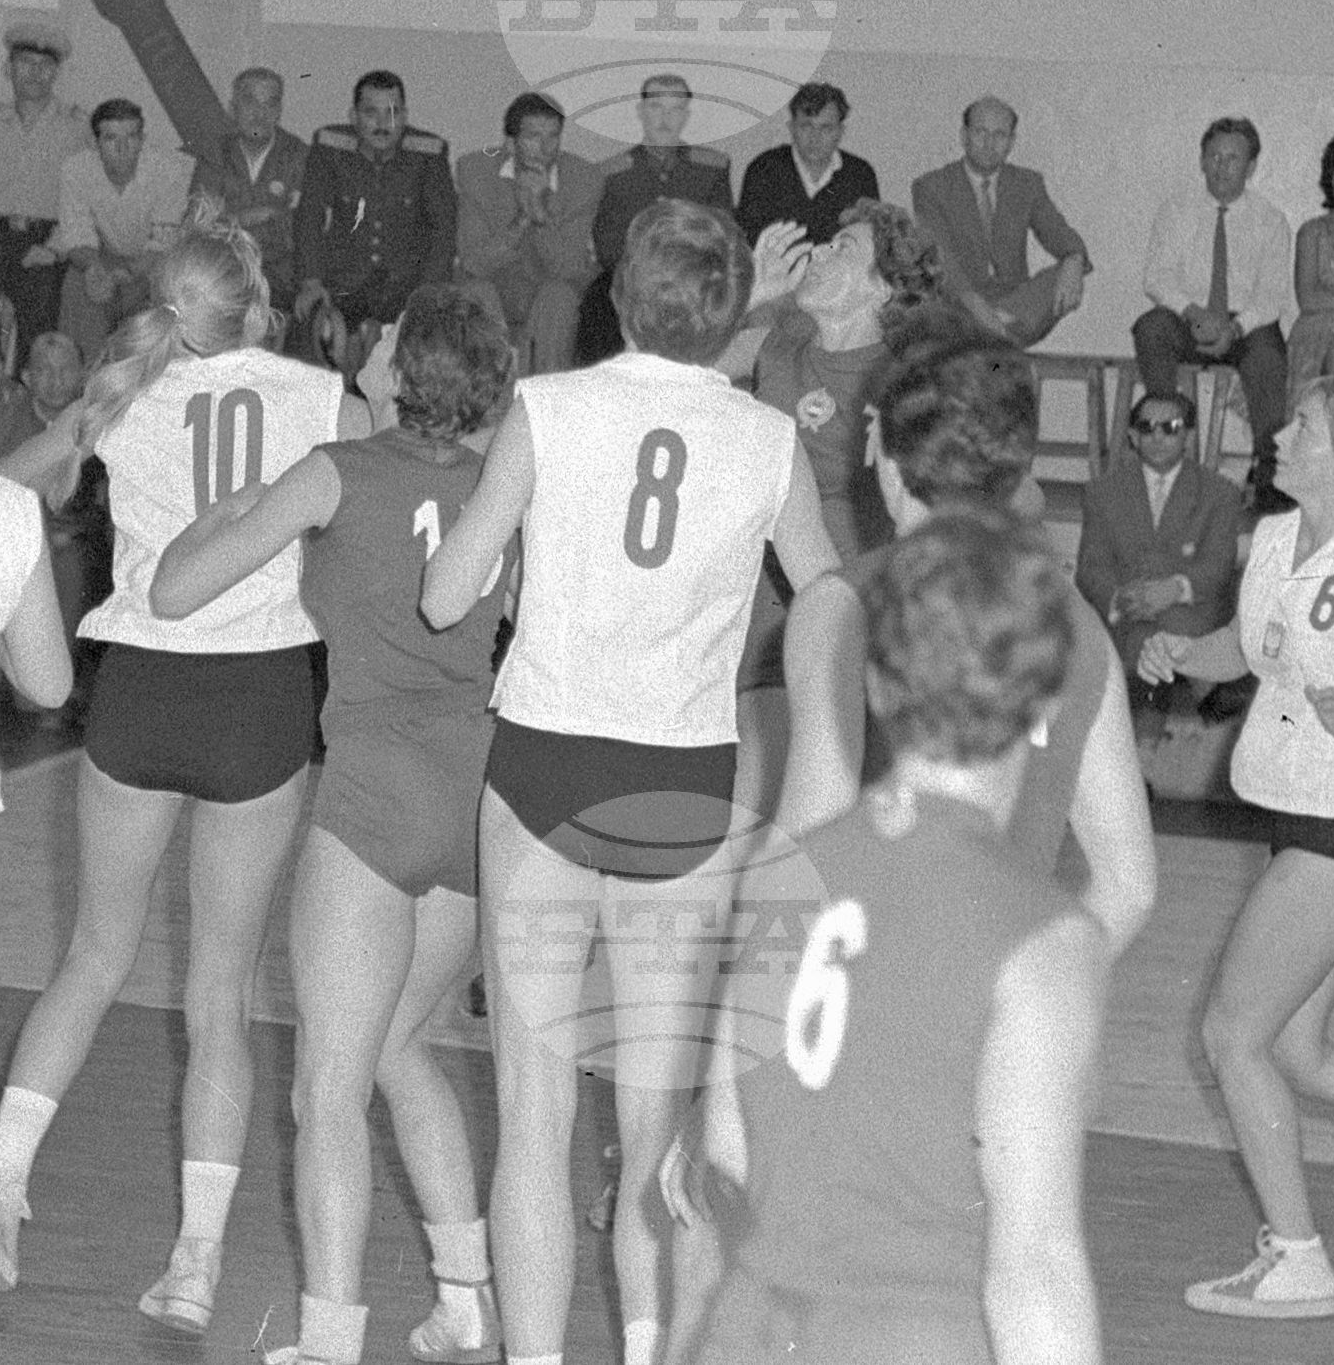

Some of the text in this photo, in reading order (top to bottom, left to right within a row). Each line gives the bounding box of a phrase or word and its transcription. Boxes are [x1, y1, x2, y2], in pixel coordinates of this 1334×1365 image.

[183, 387, 264, 517] 10
[623, 428, 687, 569] 8
[786, 898, 867, 1090] 6
